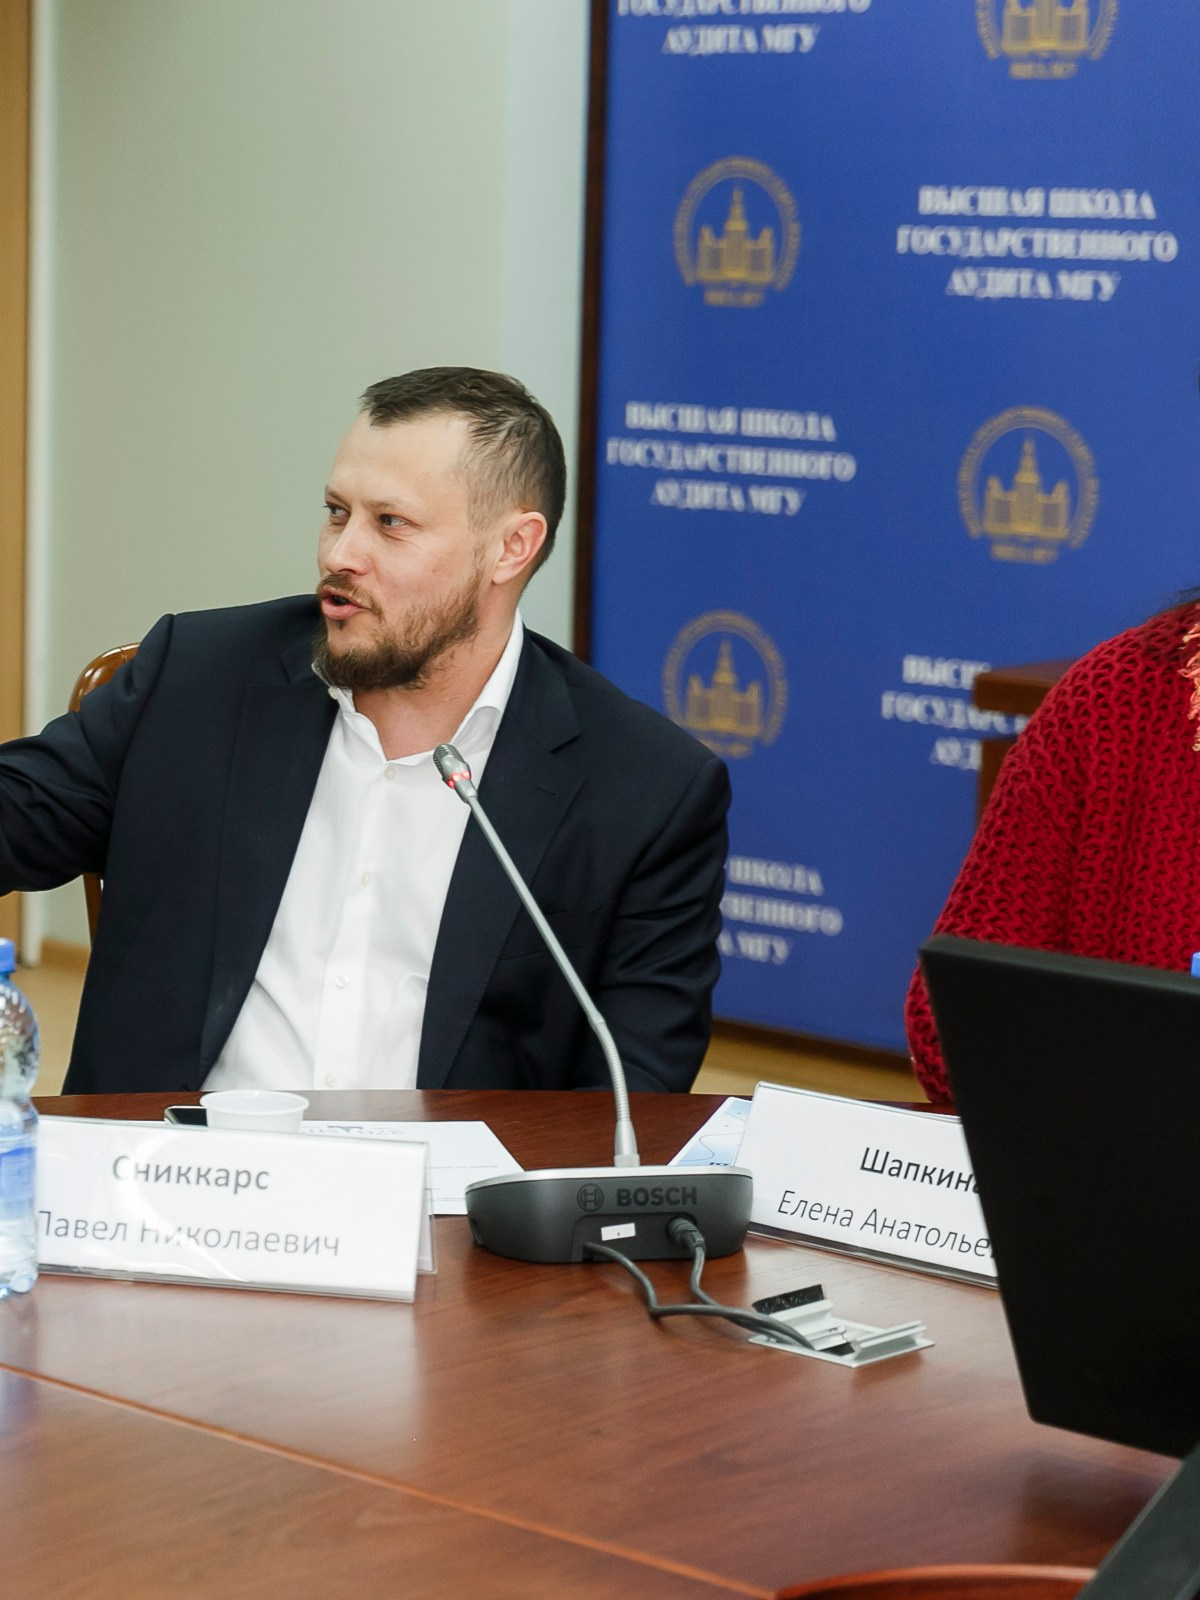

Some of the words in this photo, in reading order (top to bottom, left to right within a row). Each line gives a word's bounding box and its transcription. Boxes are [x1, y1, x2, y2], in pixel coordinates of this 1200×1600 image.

[112, 1155, 270, 1195] Сниккарс
[616, 1186, 698, 1208] BOSCH
[777, 1190, 854, 1228] Елена
[860, 1208, 995, 1258] Анатолье
